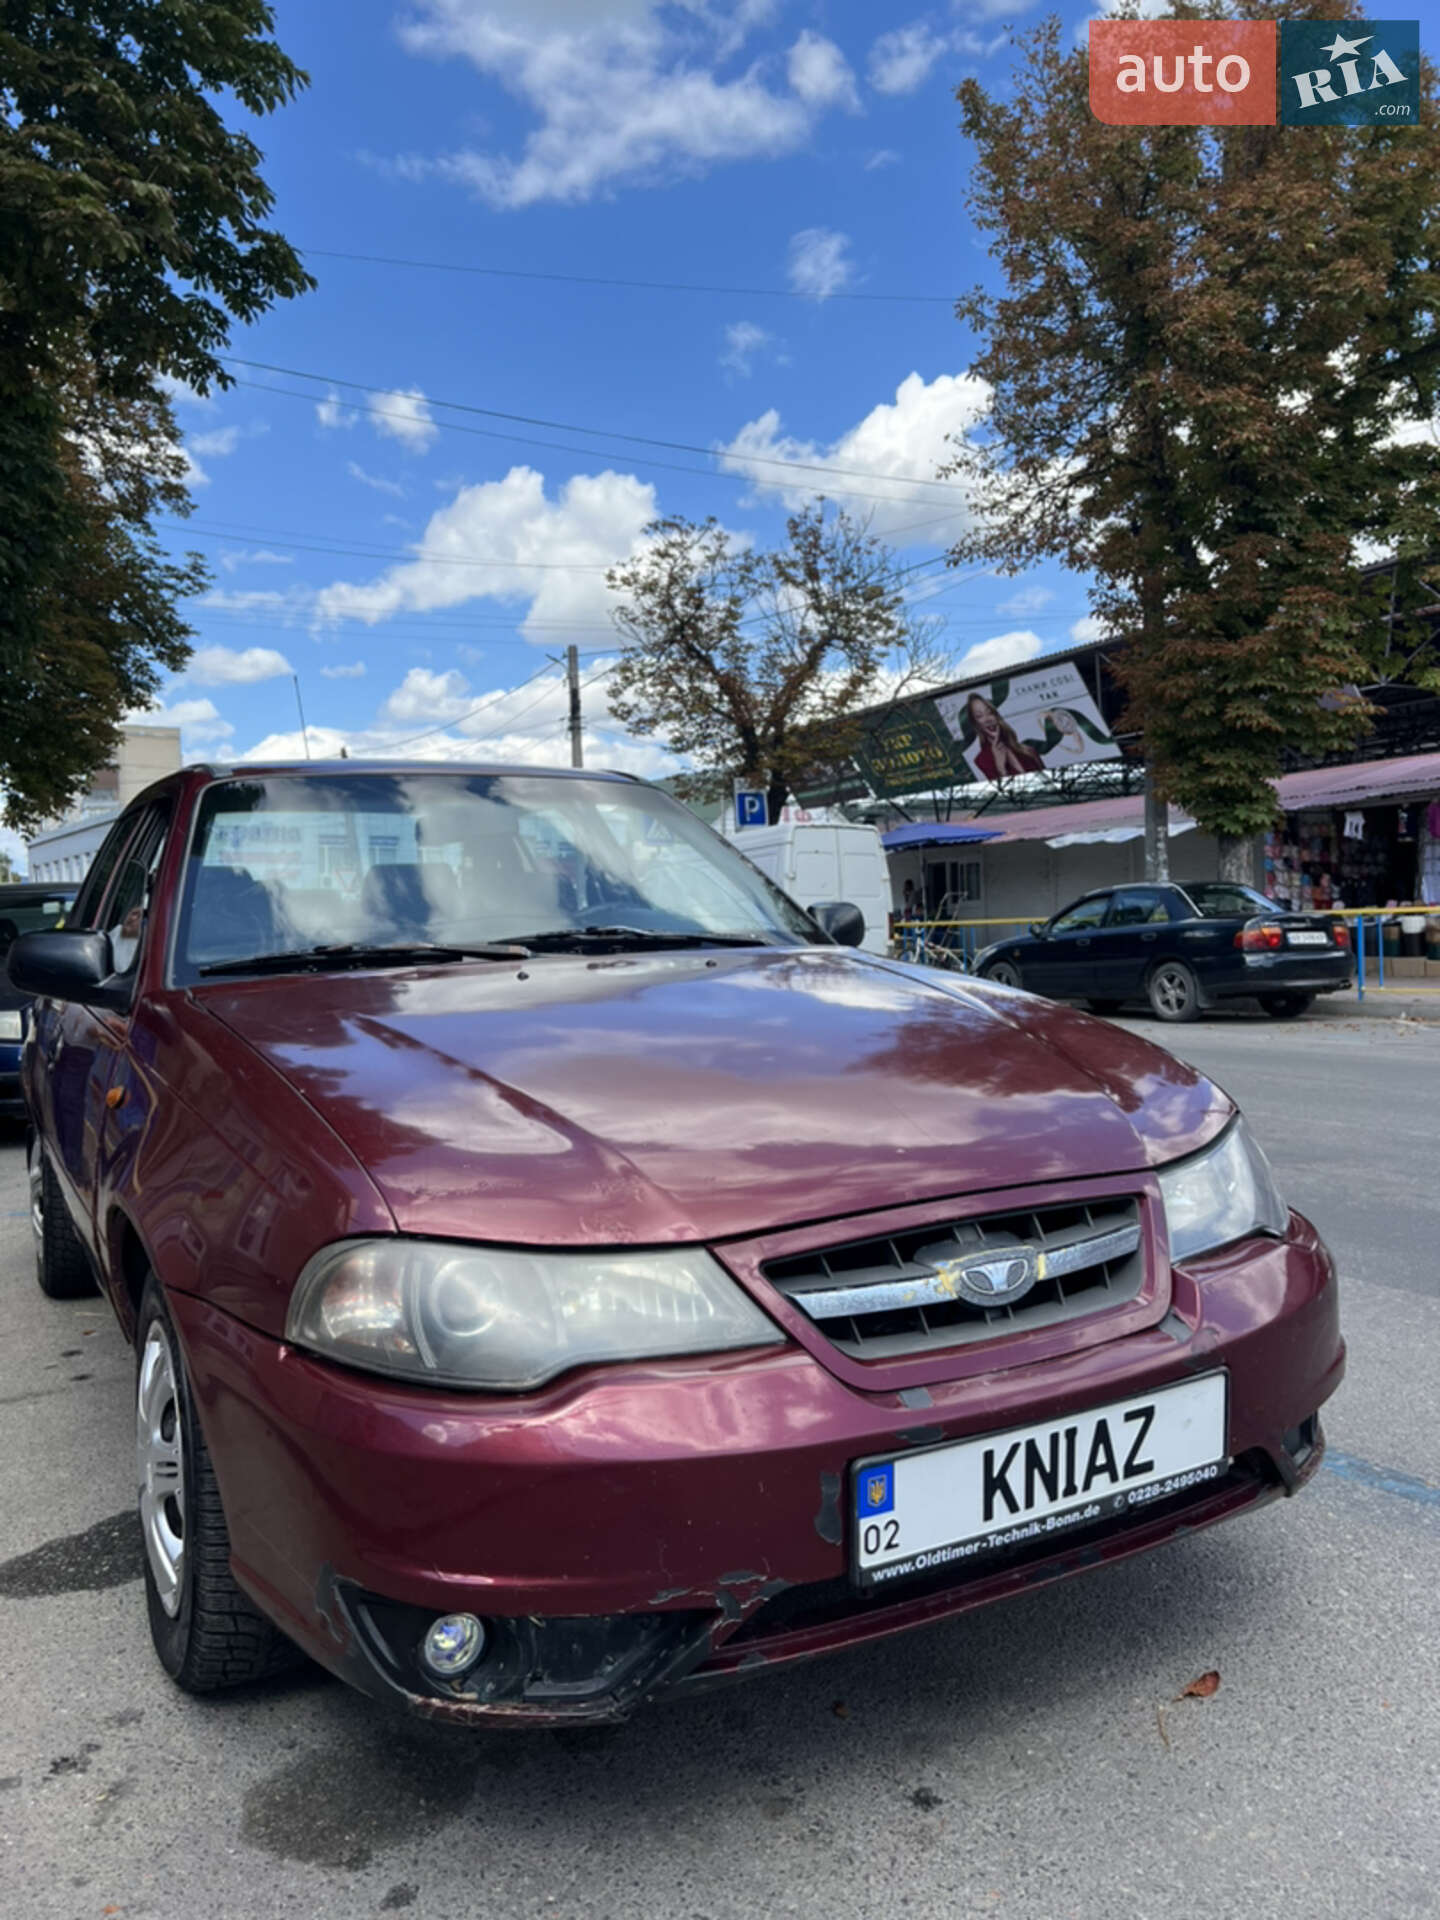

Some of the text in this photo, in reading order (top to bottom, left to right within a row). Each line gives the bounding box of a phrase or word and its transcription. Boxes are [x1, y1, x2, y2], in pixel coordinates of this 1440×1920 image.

[743, 796, 760, 822] P
[982, 1404, 1155, 1523] KNIAZ
[863, 1519, 900, 1555] 02
[871, 1503, 1101, 1583] www.Oldtimer-Technik-Bonn.de
